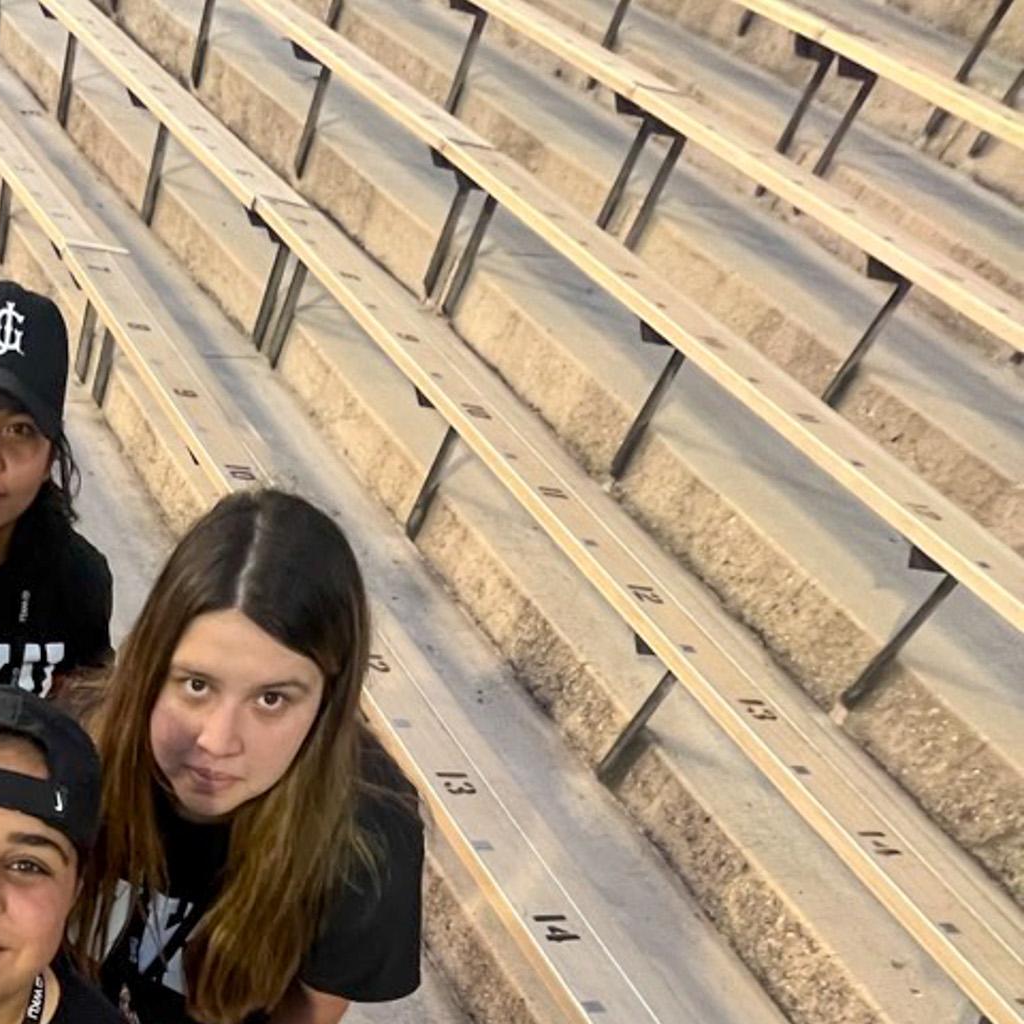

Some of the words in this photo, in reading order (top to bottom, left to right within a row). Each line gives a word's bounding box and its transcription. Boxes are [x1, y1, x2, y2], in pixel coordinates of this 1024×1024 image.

[225, 464, 257, 480] 10
[627, 585, 665, 605] 12
[737, 697, 778, 722] 13
[435, 771, 477, 796] 13
[858, 831, 902, 857] 14
[533, 914, 581, 944] 14
